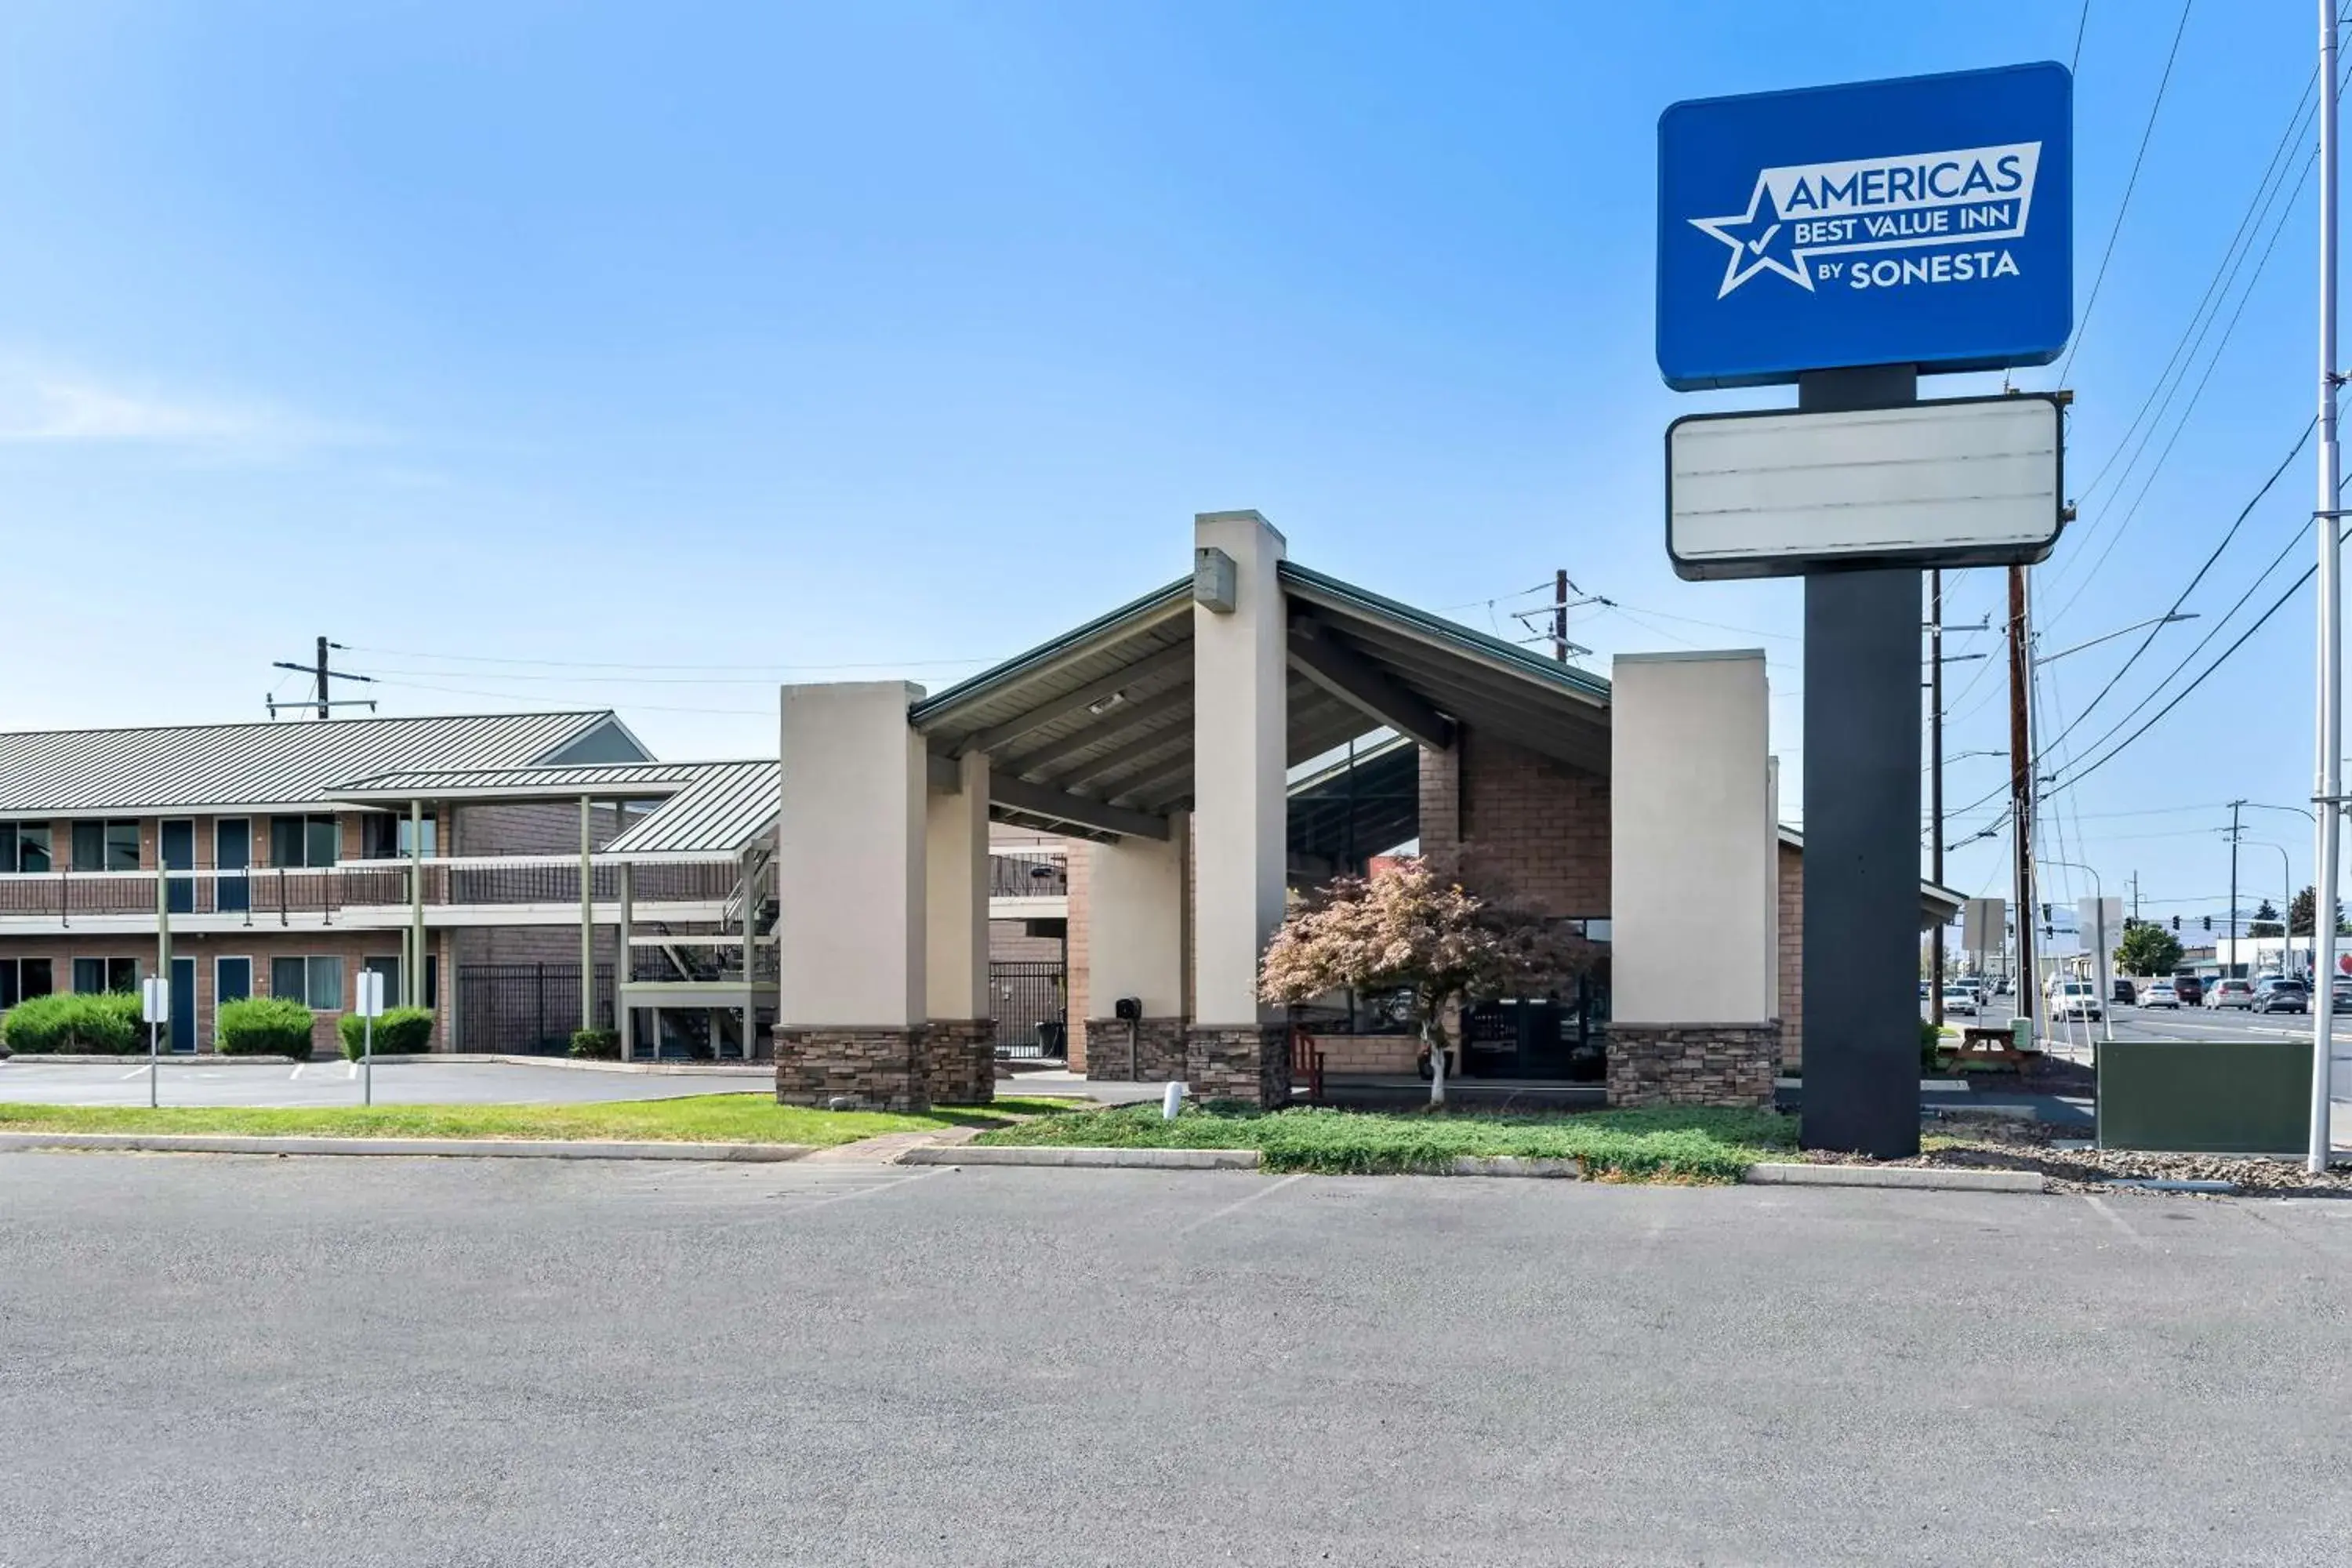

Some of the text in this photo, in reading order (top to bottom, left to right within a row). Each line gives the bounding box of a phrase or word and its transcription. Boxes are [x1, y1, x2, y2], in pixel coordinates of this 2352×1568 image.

[1784, 155, 2023, 212] AMERICAS
[1795, 205, 2009, 244] BEST VALUE INN
[1818, 249, 2020, 289] BY SONESTA
